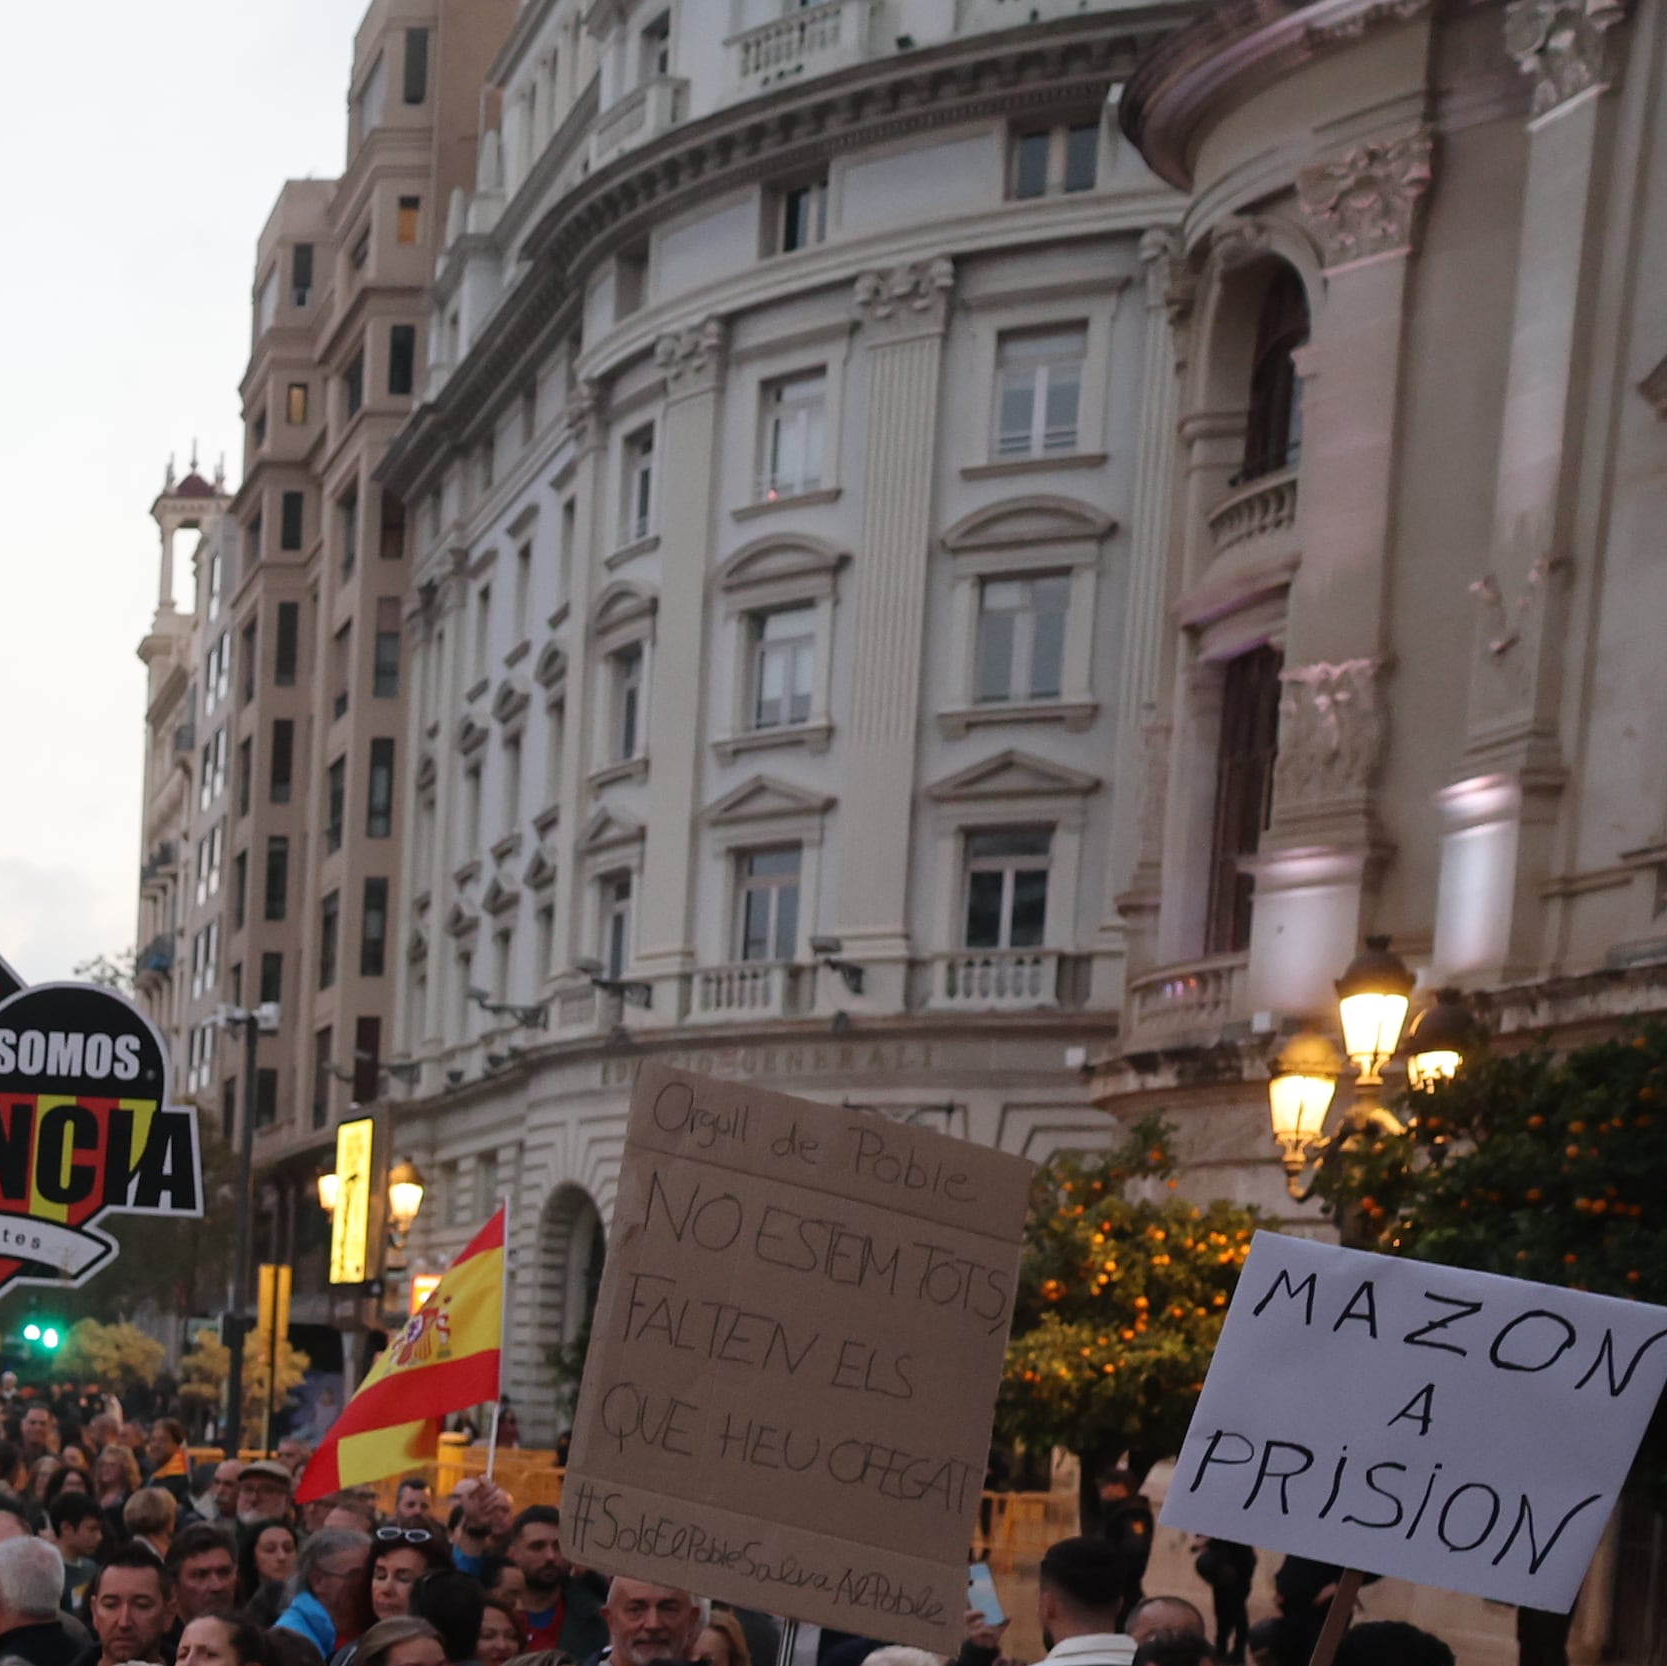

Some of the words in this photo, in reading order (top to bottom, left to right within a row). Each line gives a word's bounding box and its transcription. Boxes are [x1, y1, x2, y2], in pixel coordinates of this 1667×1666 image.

[653, 1083, 749, 1148] Orgull
[771, 1122, 820, 1165] de
[848, 1126, 976, 1203] Poble
[644, 1170, 743, 1253] NO
[755, 1206, 900, 1297] ESTEM
[623, 1271, 820, 1375] FALTEN
[831, 1338, 914, 1399] ELS
[1253, 1269, 1667, 1397] MAZON
[602, 1382, 700, 1457] QUE
[720, 1413, 820, 1472] HEU
[828, 1438, 983, 1514] OFEGAT
[1388, 1383, 1435, 1436] A
